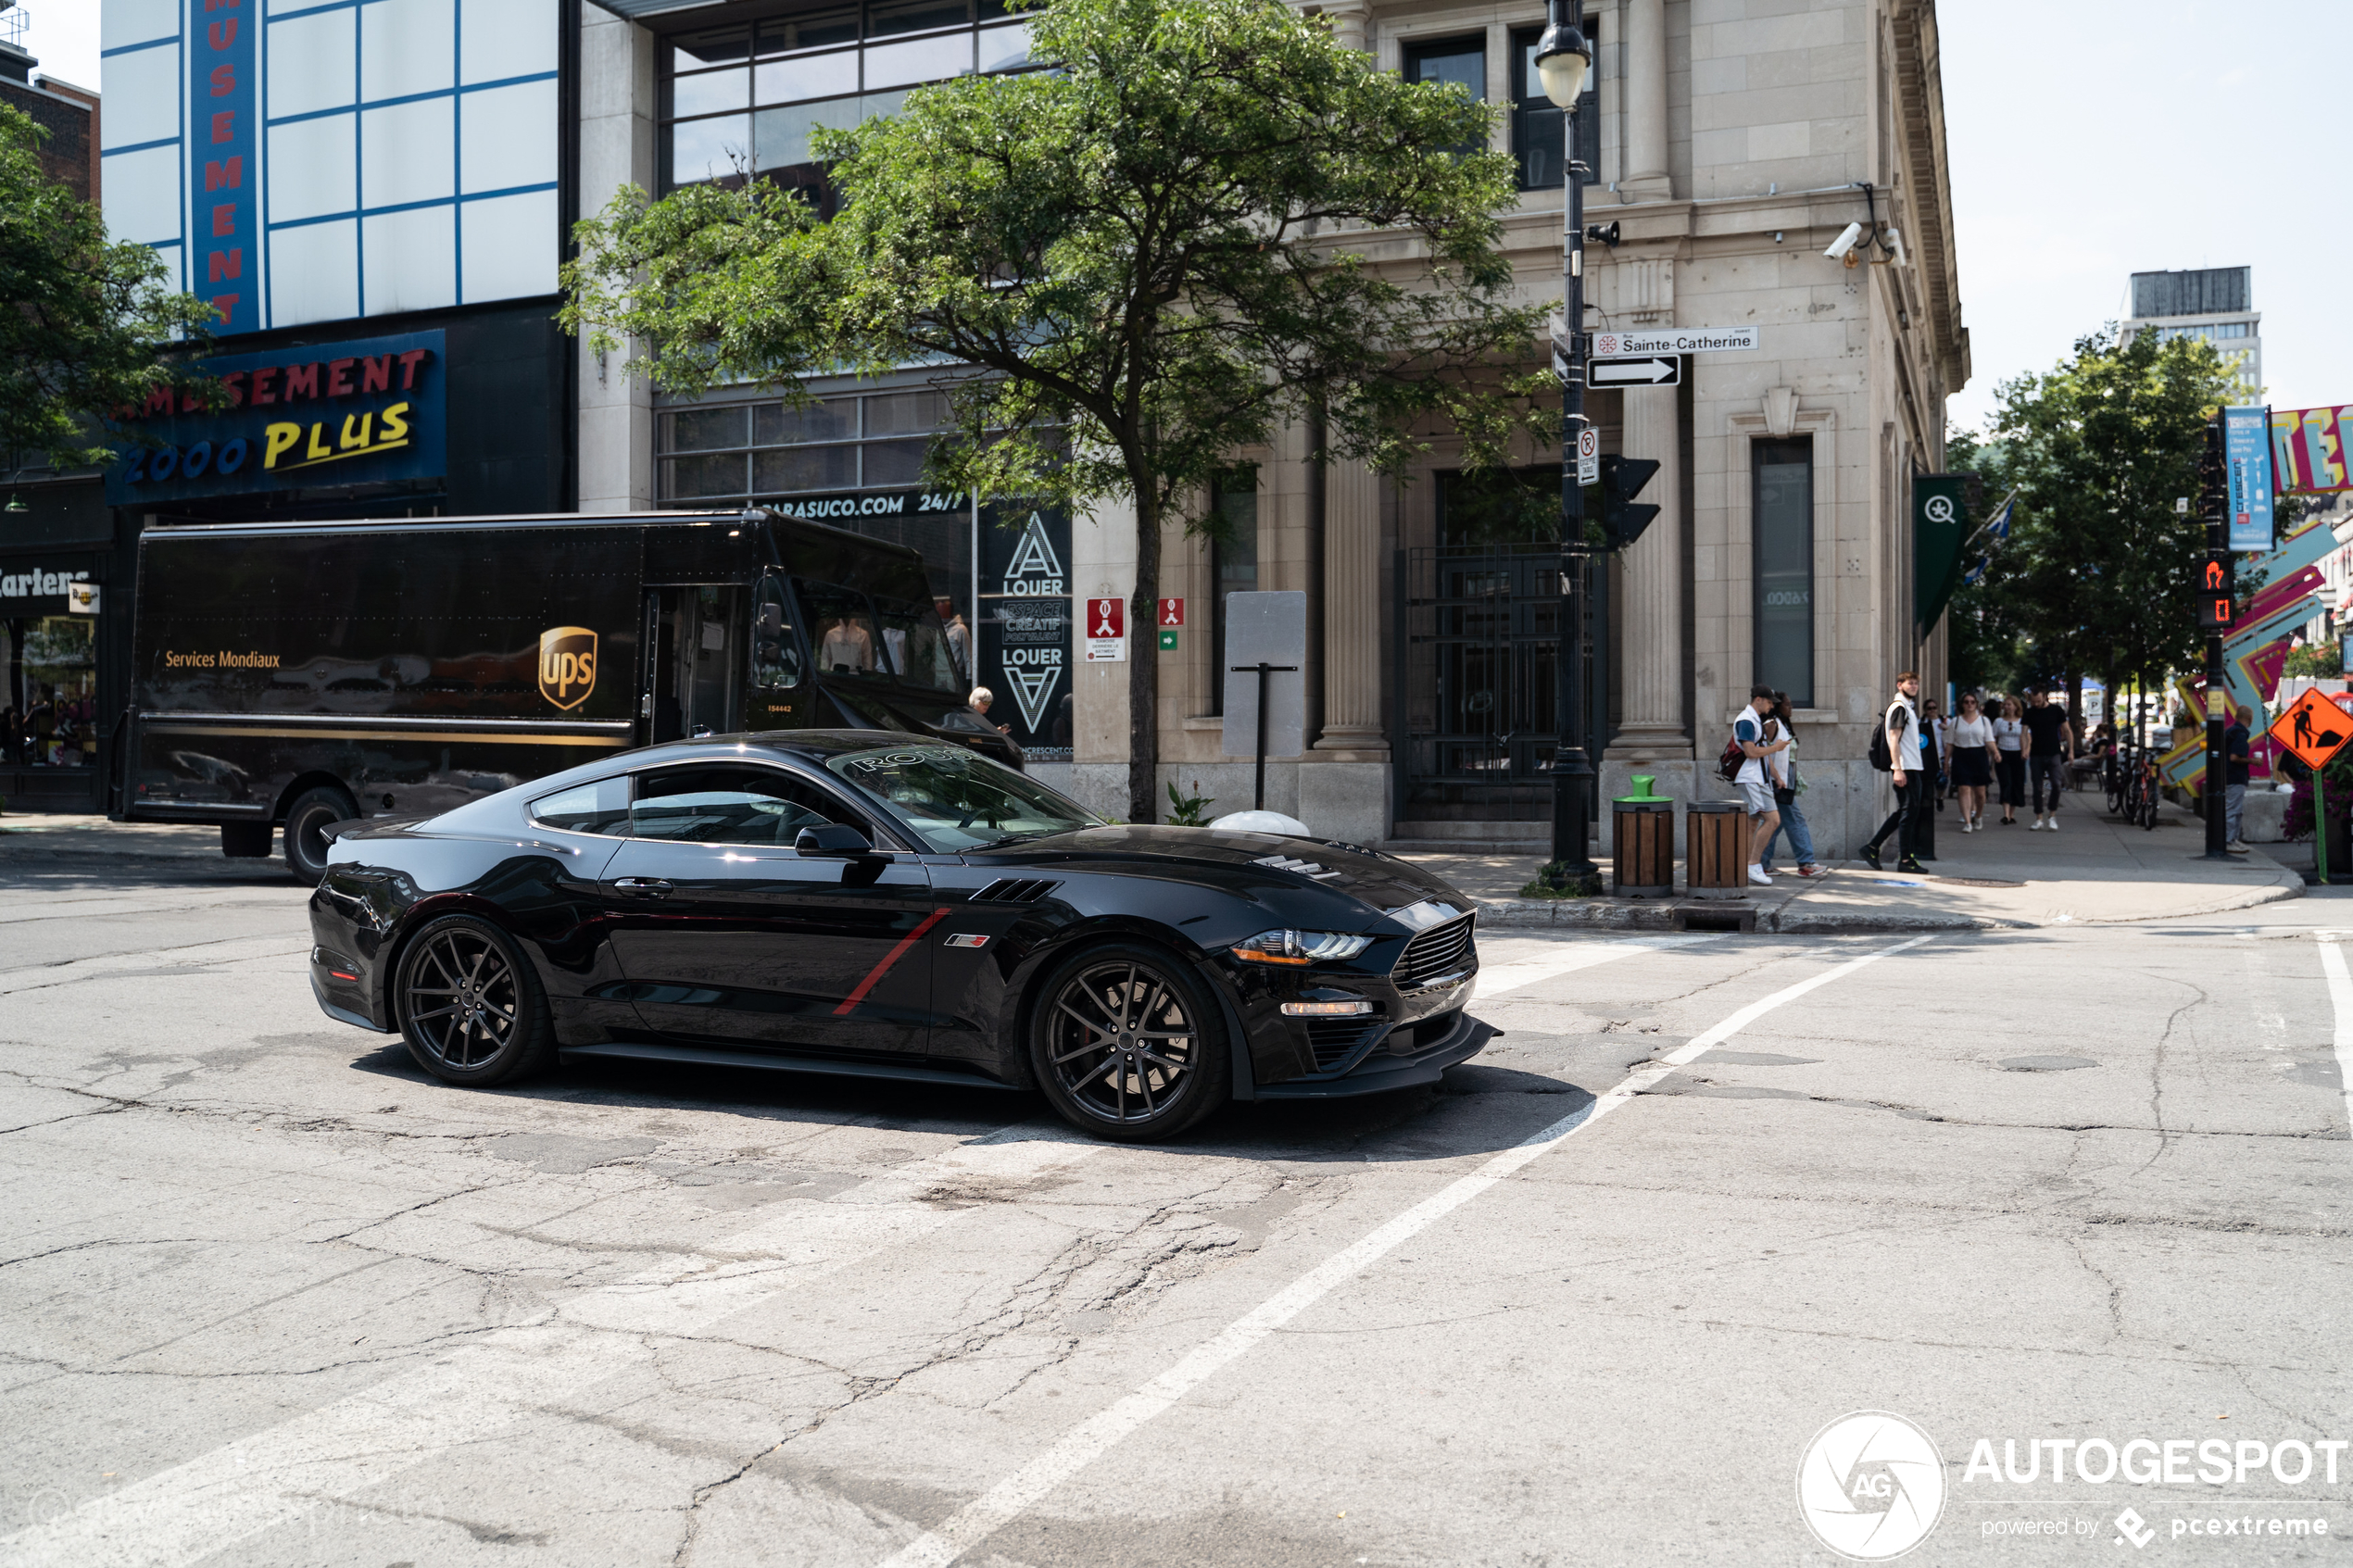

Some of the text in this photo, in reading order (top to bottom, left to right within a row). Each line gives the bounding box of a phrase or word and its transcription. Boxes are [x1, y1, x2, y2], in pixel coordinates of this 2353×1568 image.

[1623, 335, 1751, 352] Sainte-Catherine
[123, 401, 409, 484] 2000 PLUS
[918, 492, 964, 511] 24/7
[1004, 510, 1063, 579] A
[1003, 579, 1063, 596] LOUER
[1007, 603, 1062, 618] ESPACE
[1004, 632, 1062, 642] POLYVALENT
[166, 650, 280, 667] Services Mondiaux
[1002, 648, 1063, 665] LOUER
